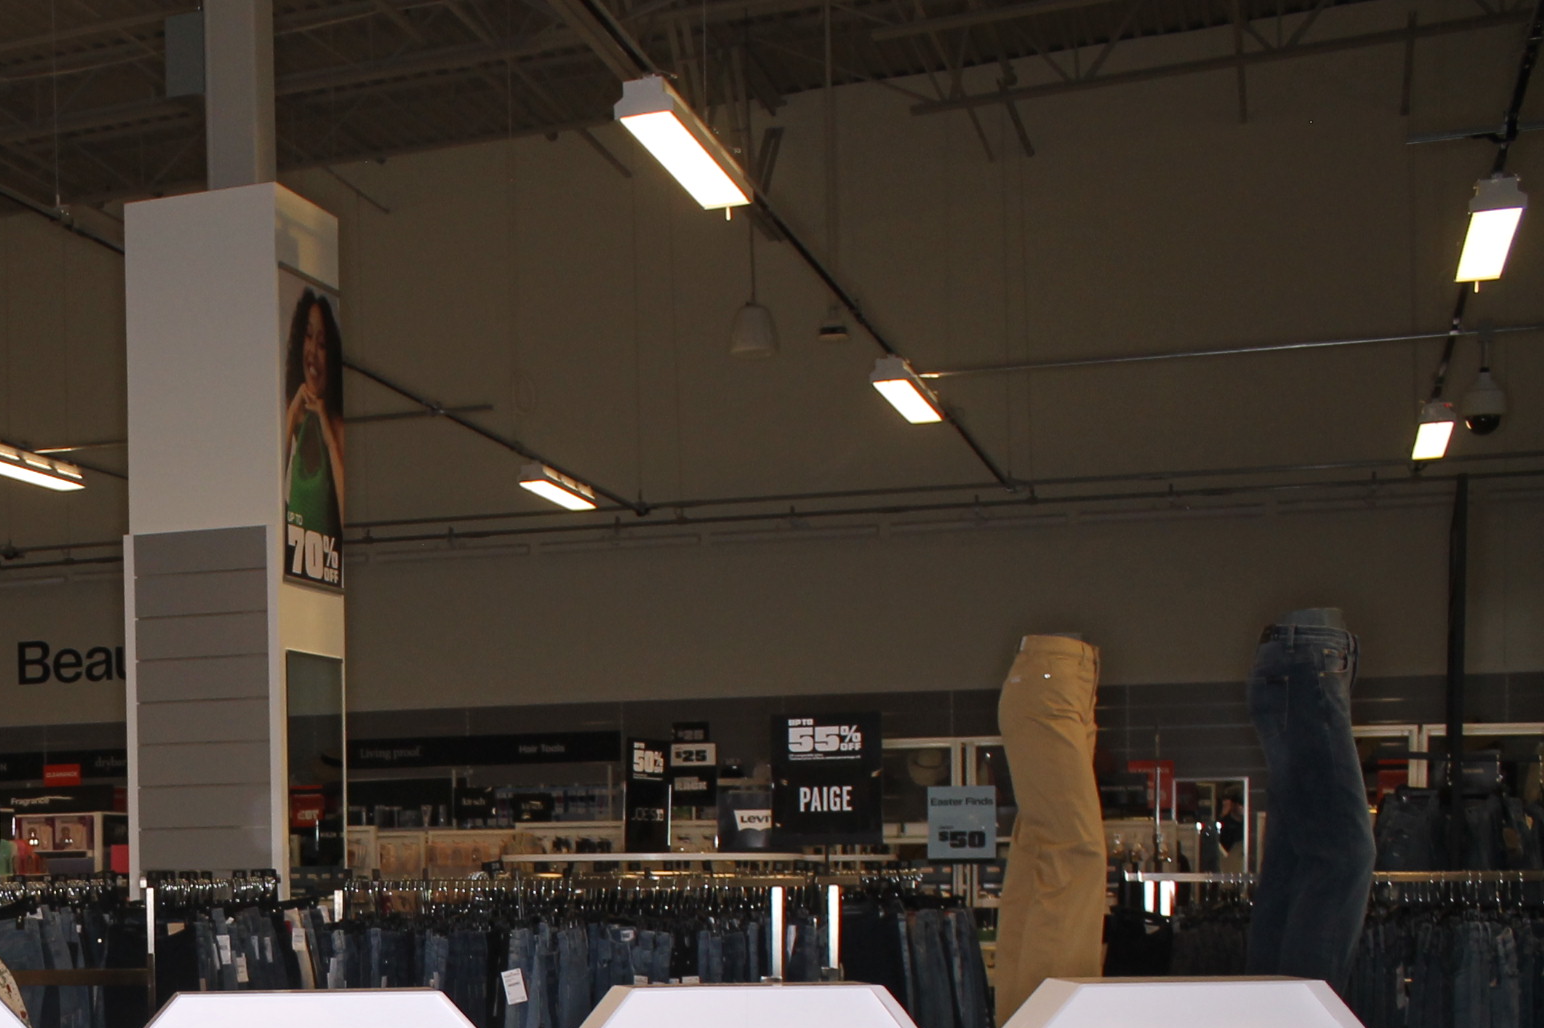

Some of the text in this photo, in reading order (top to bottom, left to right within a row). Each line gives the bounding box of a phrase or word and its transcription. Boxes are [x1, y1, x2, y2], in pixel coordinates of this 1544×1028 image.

[288, 524, 338, 579] 70%
[323, 566, 339, 584] OFF
[788, 725, 861, 752] 55%
[840, 742, 861, 751] OFF
[674, 750, 707, 763] $25
[799, 786, 853, 812] PAIGE
[931, 796, 994, 806] Easter Finds
[938, 831, 986, 848] $50
